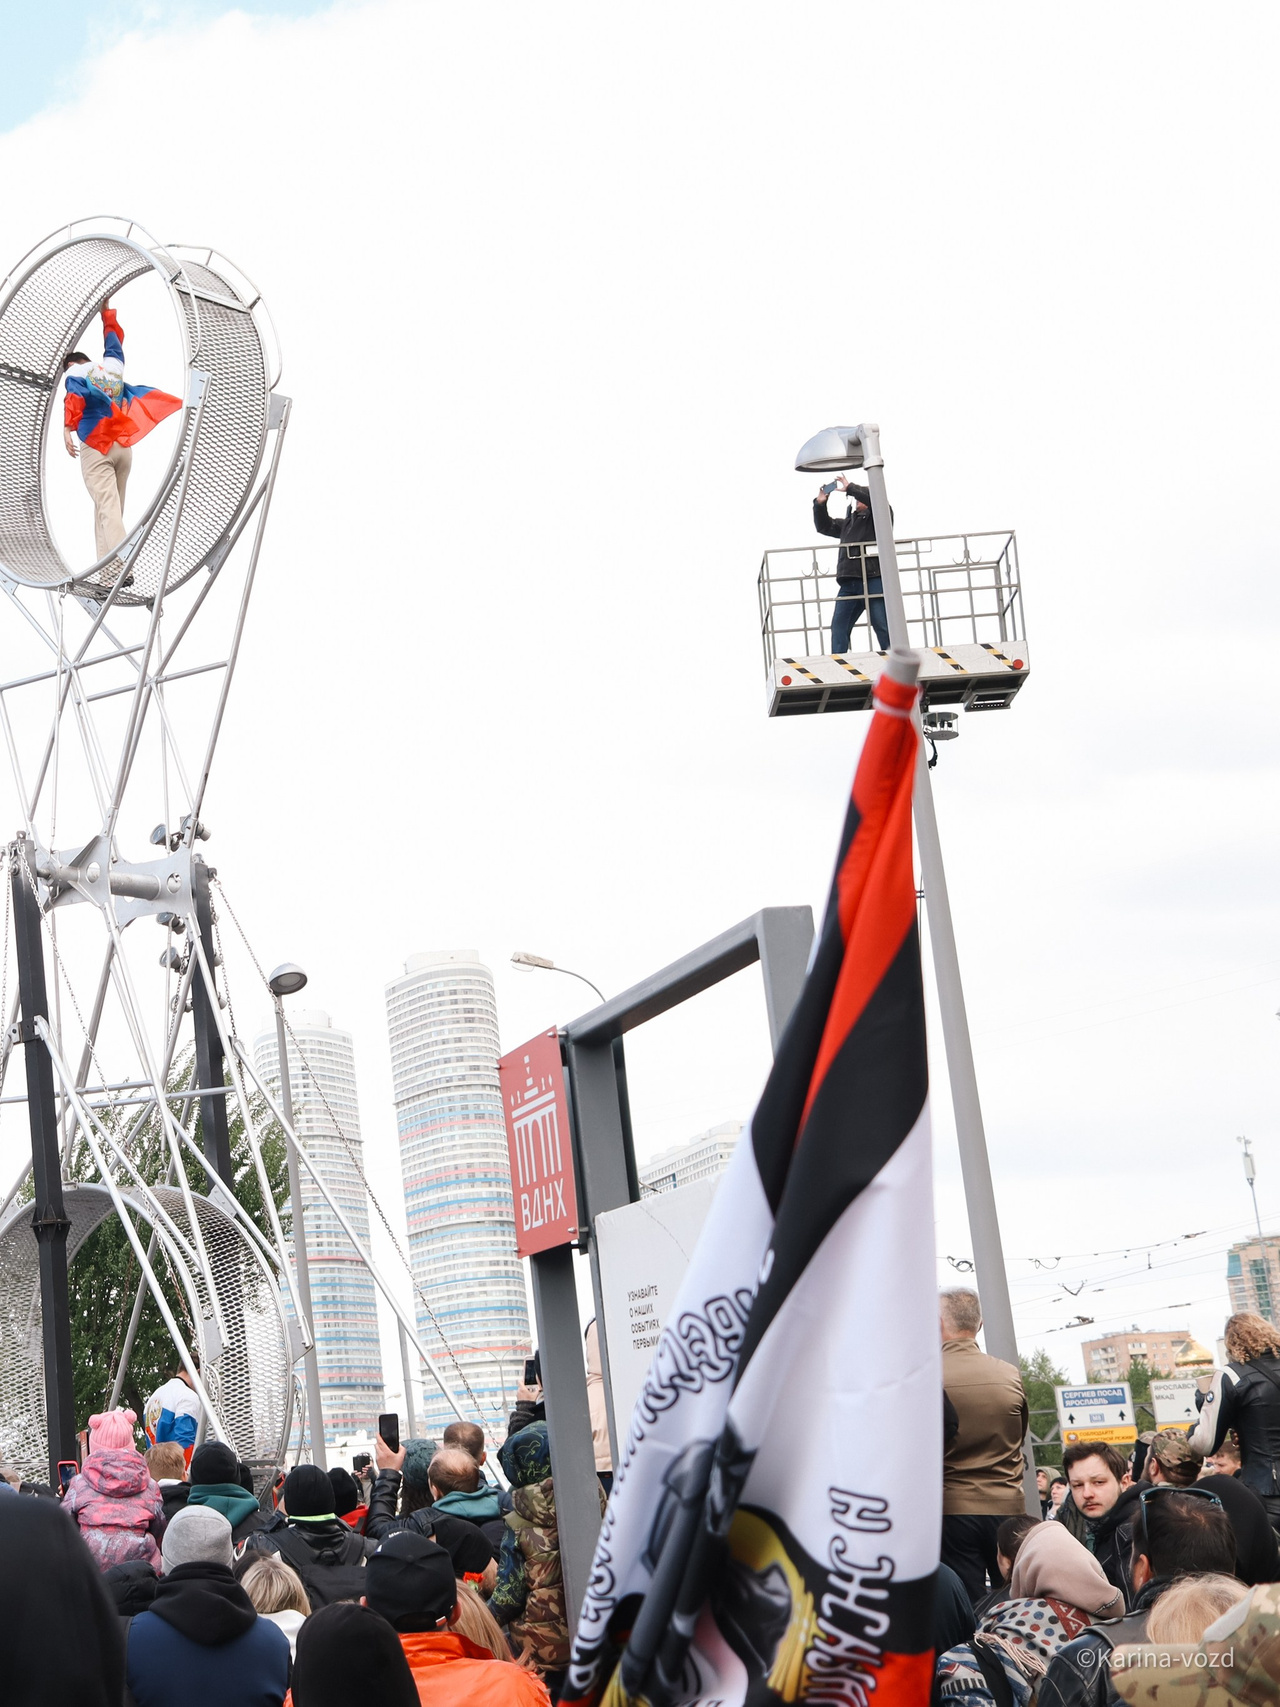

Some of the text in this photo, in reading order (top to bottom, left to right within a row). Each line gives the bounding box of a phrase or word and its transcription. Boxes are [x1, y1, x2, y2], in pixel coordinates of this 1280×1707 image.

[521, 1178, 567, 1232] ВДНХ
[627, 1284, 658, 1302] УЗНАВАЙТЕ
[634, 1303, 654, 1317] НАШИХ
[631, 1318, 660, 1334] СОБЫТИЯХ
[1064, 1389, 1124, 1399] СЕРГИЕВ ПОСАД
[1154, 1383, 1198, 1391] ЯРОСЛАВСК
[1065, 1398, 1109, 1407] ЯРОСЛАВЛЬ
